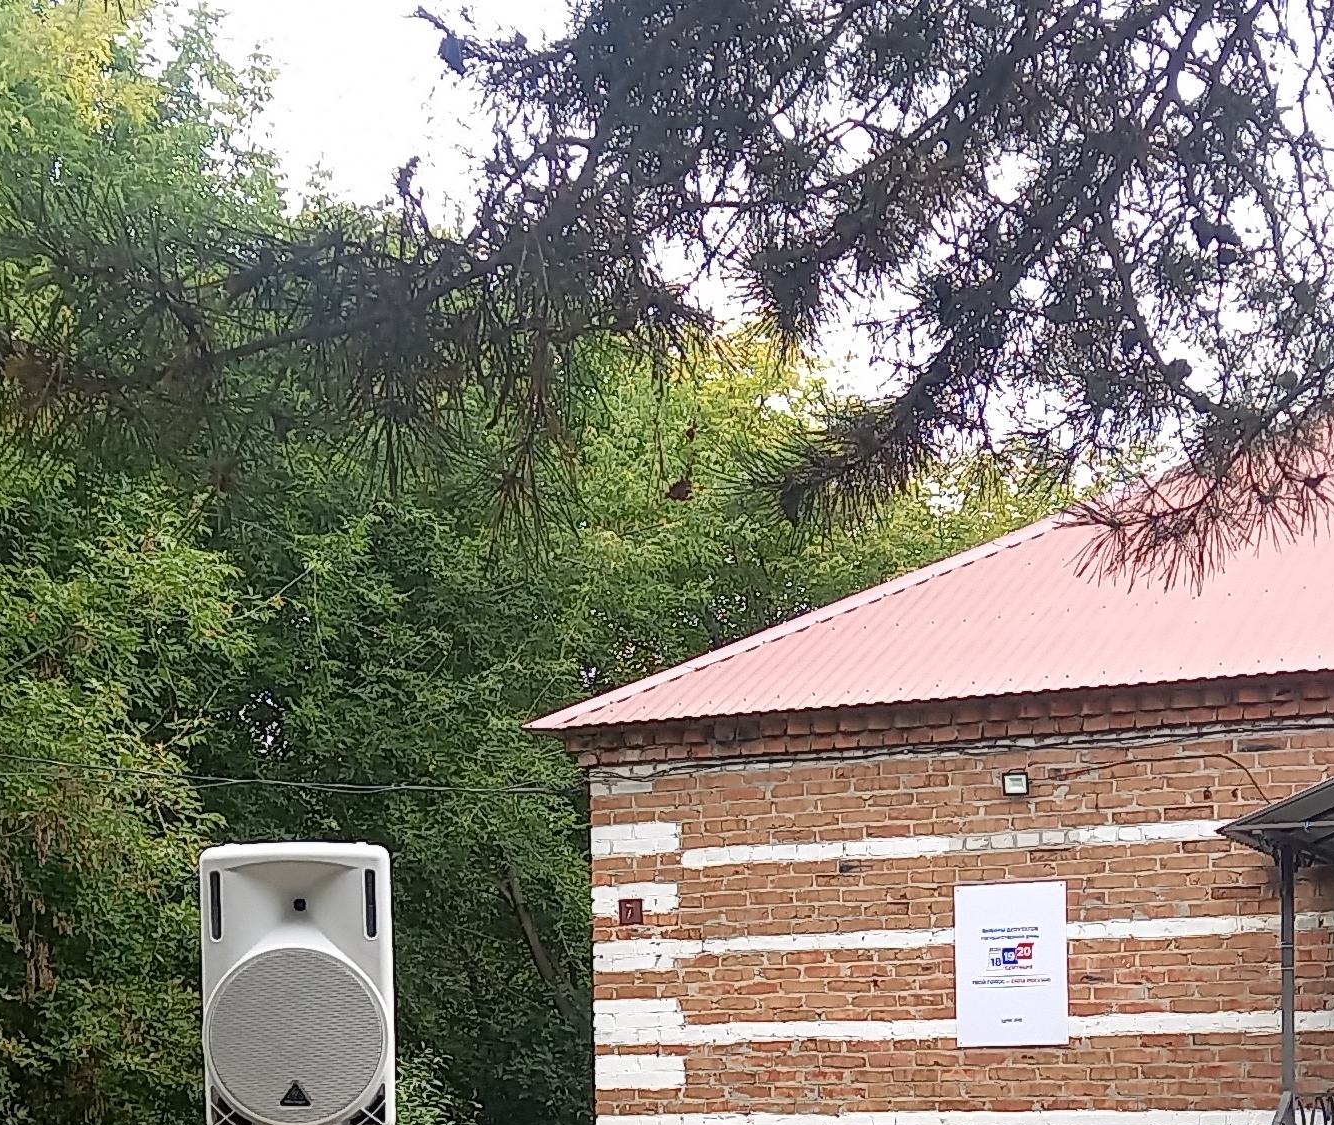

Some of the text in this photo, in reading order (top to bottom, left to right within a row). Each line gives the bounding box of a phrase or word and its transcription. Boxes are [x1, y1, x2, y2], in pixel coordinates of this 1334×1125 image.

[1003, 951, 1015, 962] 19
[1016, 946, 1031, 957] 20
[990, 957, 1002, 967] 18
